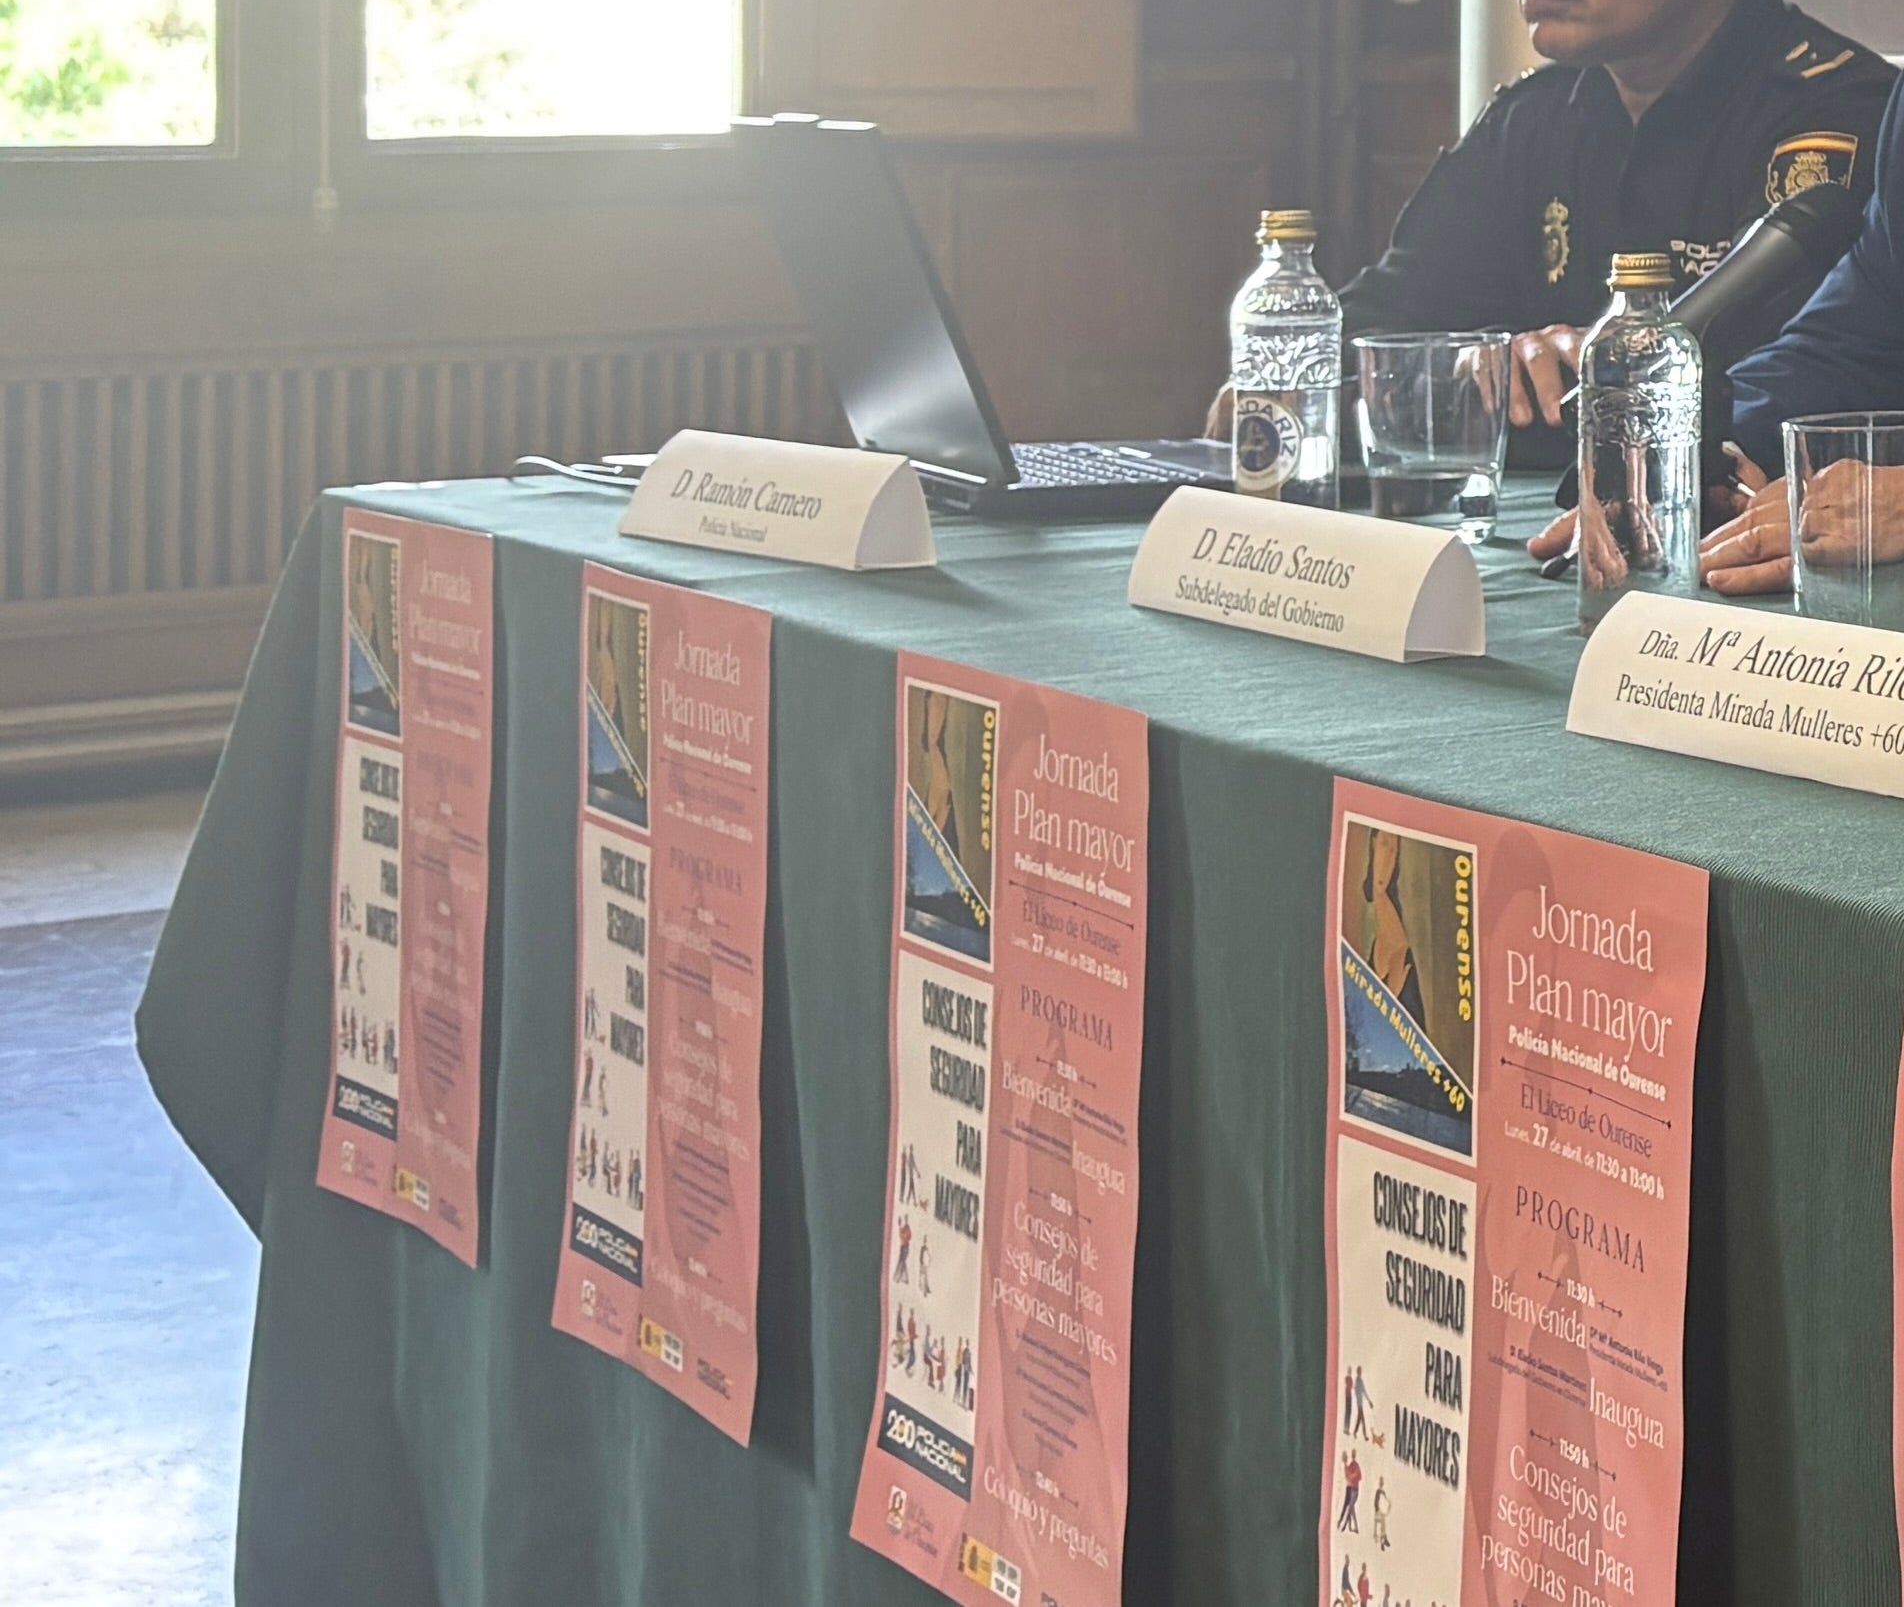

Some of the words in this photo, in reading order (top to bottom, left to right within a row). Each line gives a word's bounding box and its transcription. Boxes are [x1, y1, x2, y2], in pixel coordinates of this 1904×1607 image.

[1237, 396, 1297, 457] DARIZ
[693, 472, 753, 509] Ramón
[754, 481, 822, 520] Carnero
[1193, 528, 1217, 562] D.
[1218, 533, 1283, 575] Eladio
[1285, 545, 1355, 589] Santos
[1176, 575, 1256, 616] Subdelegado
[1258, 591, 1280, 619] del
[1283, 597, 1345, 633] Gobierno
[1638, 629, 1679, 660] Dña.
[1687, 626, 1739, 667] Mª
[1733, 635, 1852, 689] Antonia
[1616, 674, 1704, 717] Presidenta
[1709, 691, 1774, 731] Mirada
[1779, 705, 1864, 748] Mulleres
[1034, 733, 1119, 803] Jornada
[1014, 788, 1061, 848] Plan
[1068, 818, 1135, 877] mayor
[1455, 855, 1472, 1022] Ourense
[1532, 884, 1654, 972] Jornada
[1020, 984, 1113, 1052] PROGRAMA
[1507, 950, 1573, 1023] Plan
[1582, 988, 1673, 1063] mayor
[1508, 1024, 1549, 1056] Policía
[1551, 1038, 1603, 1076] Nacional
[1443, 1078, 1465, 1113] +60
[1538, 1089, 1576, 1124] Liceo
[1579, 1105, 1596, 1133] de
[1600, 1113, 1652, 1158] Ourense
[1532, 1122, 1549, 1148] 27
[1013, 1202, 1078, 1261] Consejos
[1373, 1171, 1446, 1253] CONSEJOS
[1449, 1199, 1468, 1260] DE
[1516, 1185, 1644, 1274] PROGRAMA
[1386, 1250, 1465, 1336] SEGURIDAD
[1491, 1274, 1586, 1349] Bienvenida
[1058, 1310, 1117, 1366] mayores
[1425, 1341, 1463, 1414] PARA
[1394, 1402, 1460, 1490] MAYORES
[1589, 1377, 1664, 1450] Inaugura
[1510, 1445, 1598, 1522] Consejos
[1603, 1496, 1627, 1539] de
[1481, 1535, 1566, 1603] personas
[1497, 1494, 1590, 1566] seguridad
[1594, 1548, 1635, 1595] para
